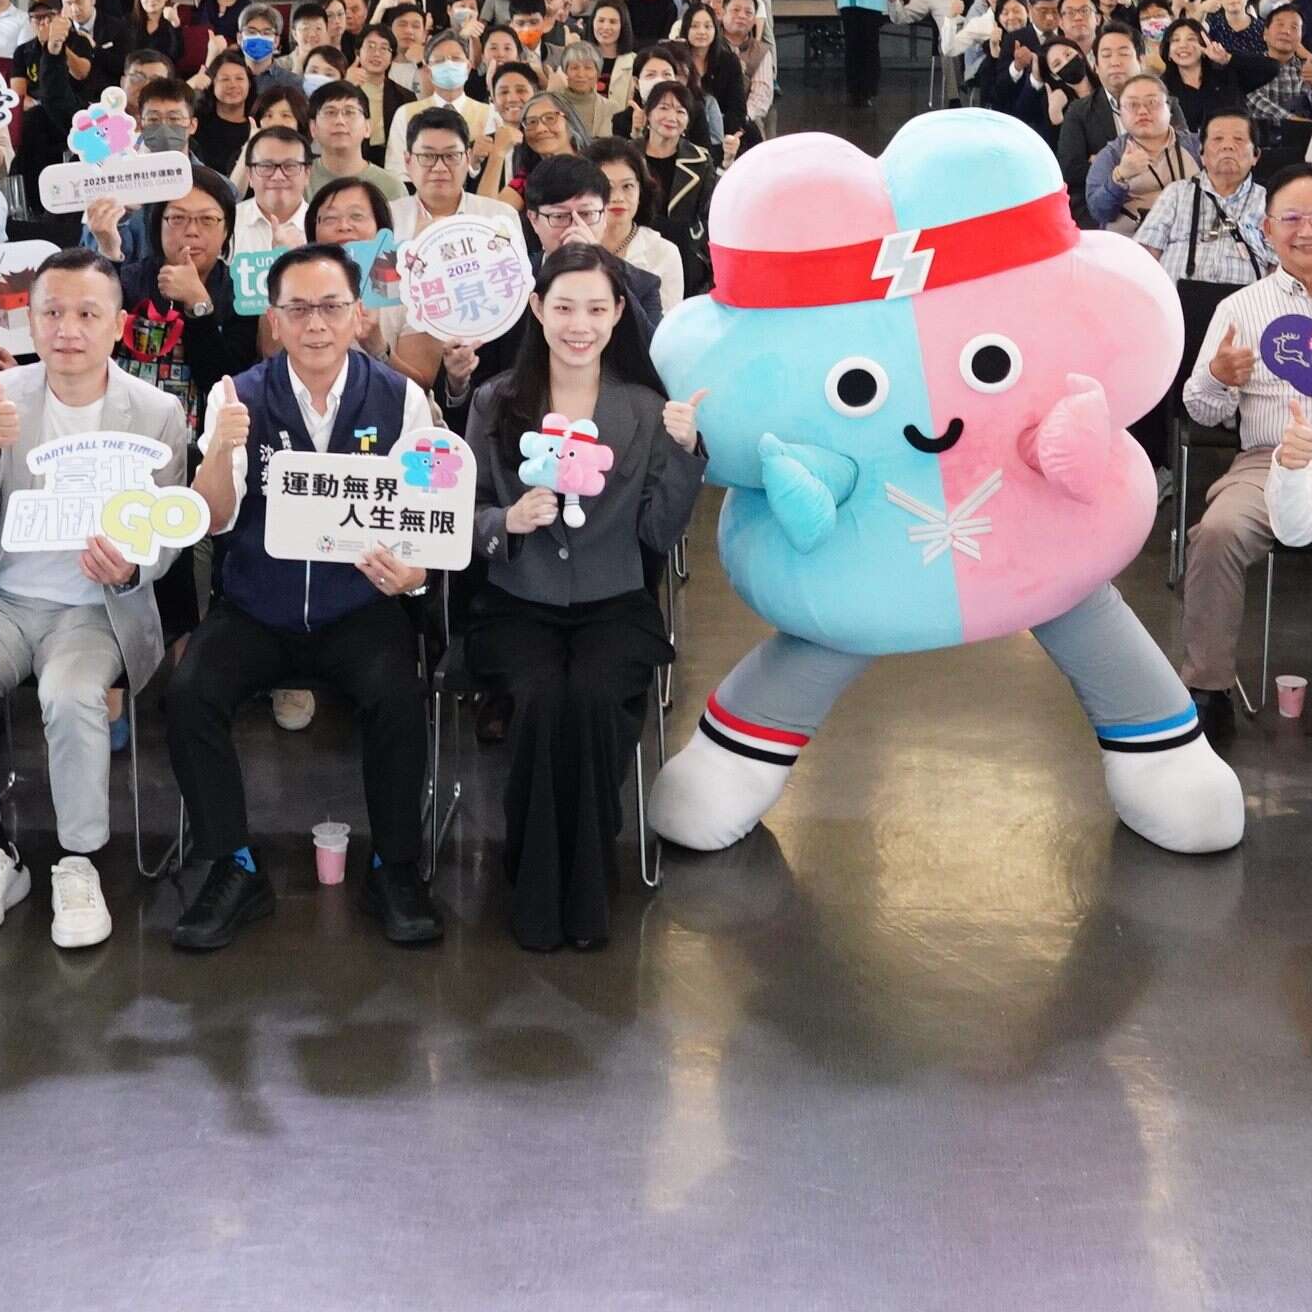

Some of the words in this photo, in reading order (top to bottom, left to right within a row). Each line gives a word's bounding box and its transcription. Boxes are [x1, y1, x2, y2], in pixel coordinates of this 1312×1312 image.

[448, 260, 480, 277] 2025
[35, 442, 73, 464] PARTY
[76, 440, 98, 452] ALL
[102, 440, 123, 449] THE
[128, 442, 163, 460] TIME!
[282, 471, 398, 502] 運動無界
[339, 504, 455, 535] 人生無限
